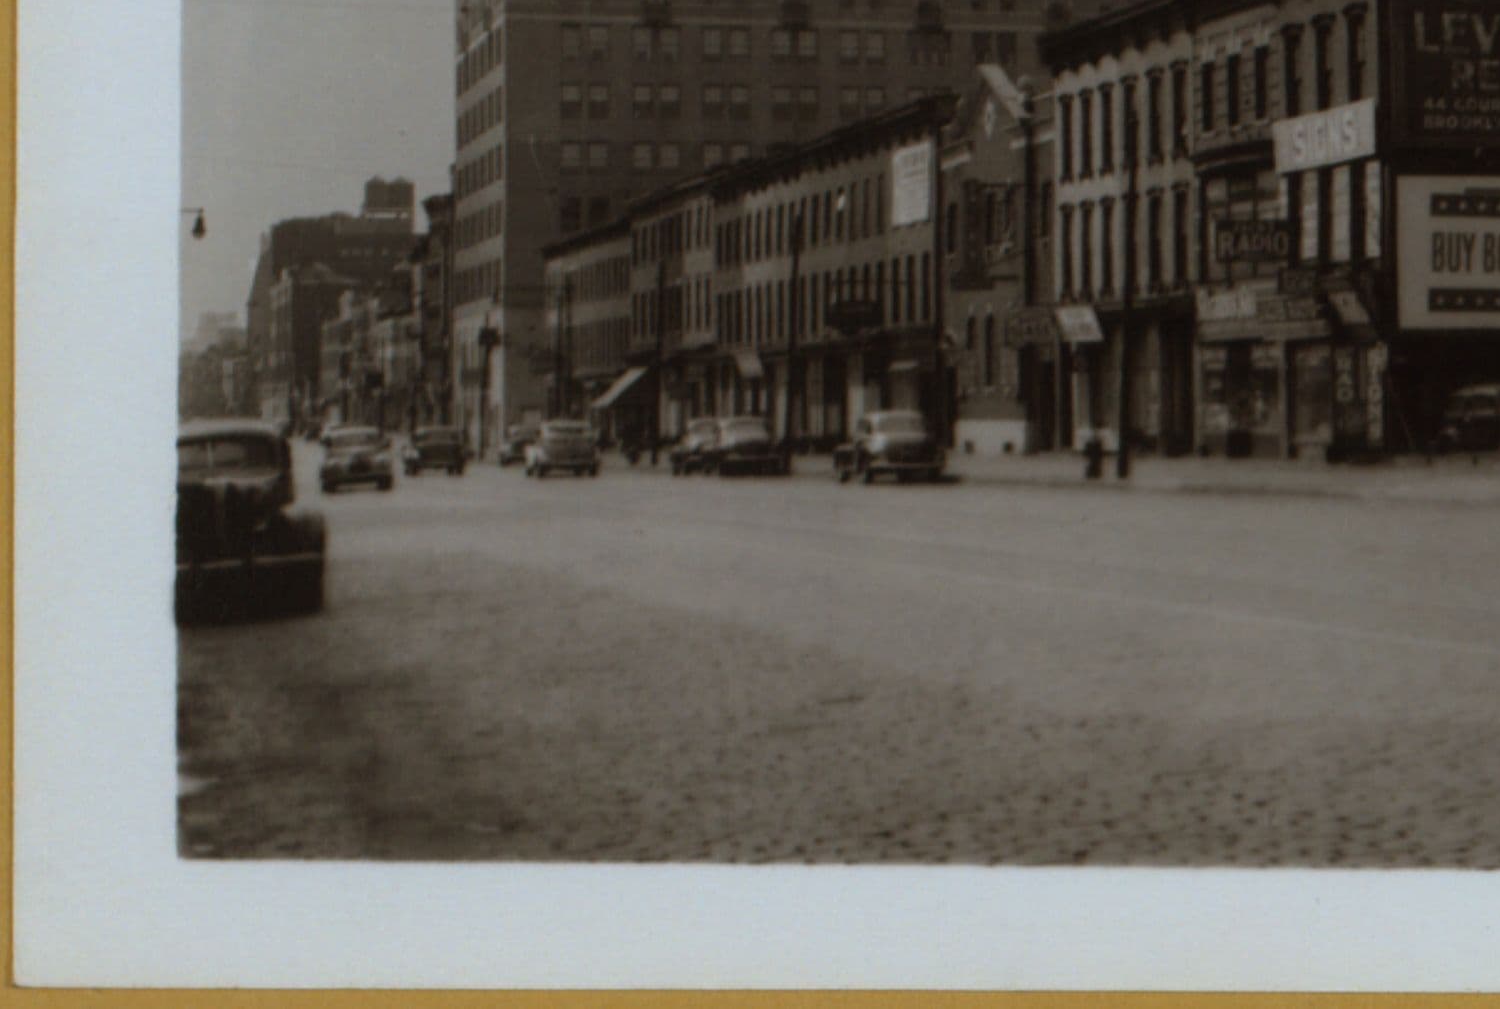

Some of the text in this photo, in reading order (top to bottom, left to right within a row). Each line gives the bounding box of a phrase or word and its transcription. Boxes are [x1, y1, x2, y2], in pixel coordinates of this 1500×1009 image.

[1423, 97, 1448, 112] 44
[1291, 107, 1360, 164] SIGNS
[1217, 228, 1290, 258] RADIO
[1431, 231, 1475, 274] BUY
